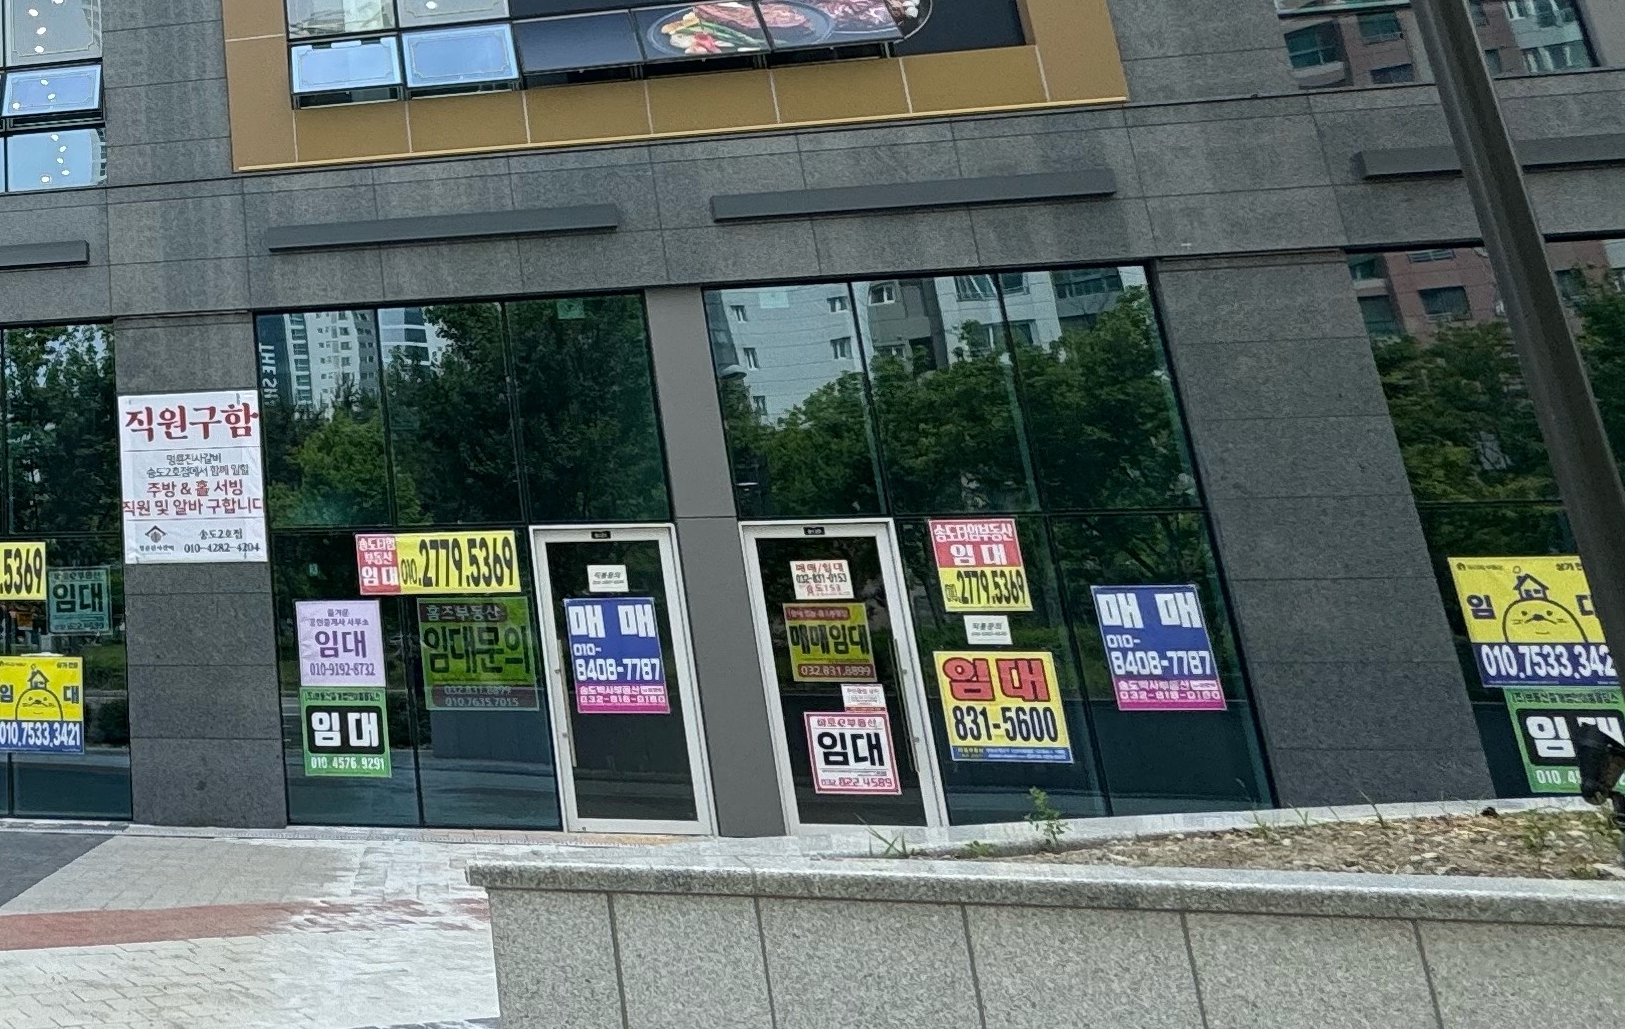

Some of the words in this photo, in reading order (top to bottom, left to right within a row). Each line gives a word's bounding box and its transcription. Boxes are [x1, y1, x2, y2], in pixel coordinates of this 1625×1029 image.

[124, 402, 260, 443] 직원구함
[166, 453, 222, 466] 명륜진사갈비
[210, 464, 229, 476] 함께
[147, 480, 177, 499] 주방
[180, 482, 192, 495] &
[195, 479, 210, 497] 홀
[214, 478, 244, 497] 서빙
[123, 498, 152, 518] 직원
[155, 498, 169, 516] 및
[172, 498, 204, 515] 알바
[949, 543, 1008, 566] 임대
[361, 566, 399, 587] 임대
[52, 583, 104, 613] 임대
[426, 604, 503, 621] 홈즈부동산
[1095, 592, 1203, 628] 매매
[567, 603, 656, 639] 매매
[314, 630, 367, 659] 임대
[423, 625, 531, 675] 임대문의
[572, 642, 603, 656] 010-
[788, 624, 870, 655] 매매임대
[1106, 634, 1142, 649] 010-
[575, 657, 661, 681] 8408-7787
[1110, 650, 1212, 675] 8408-7787
[1480, 644, 1618, 679] 010.7533.342
[942, 656, 1052, 703] 임대
[311, 711, 380, 748] 임대
[952, 705, 1059, 743] 831-5600
[817, 731, 885, 767] 임대
